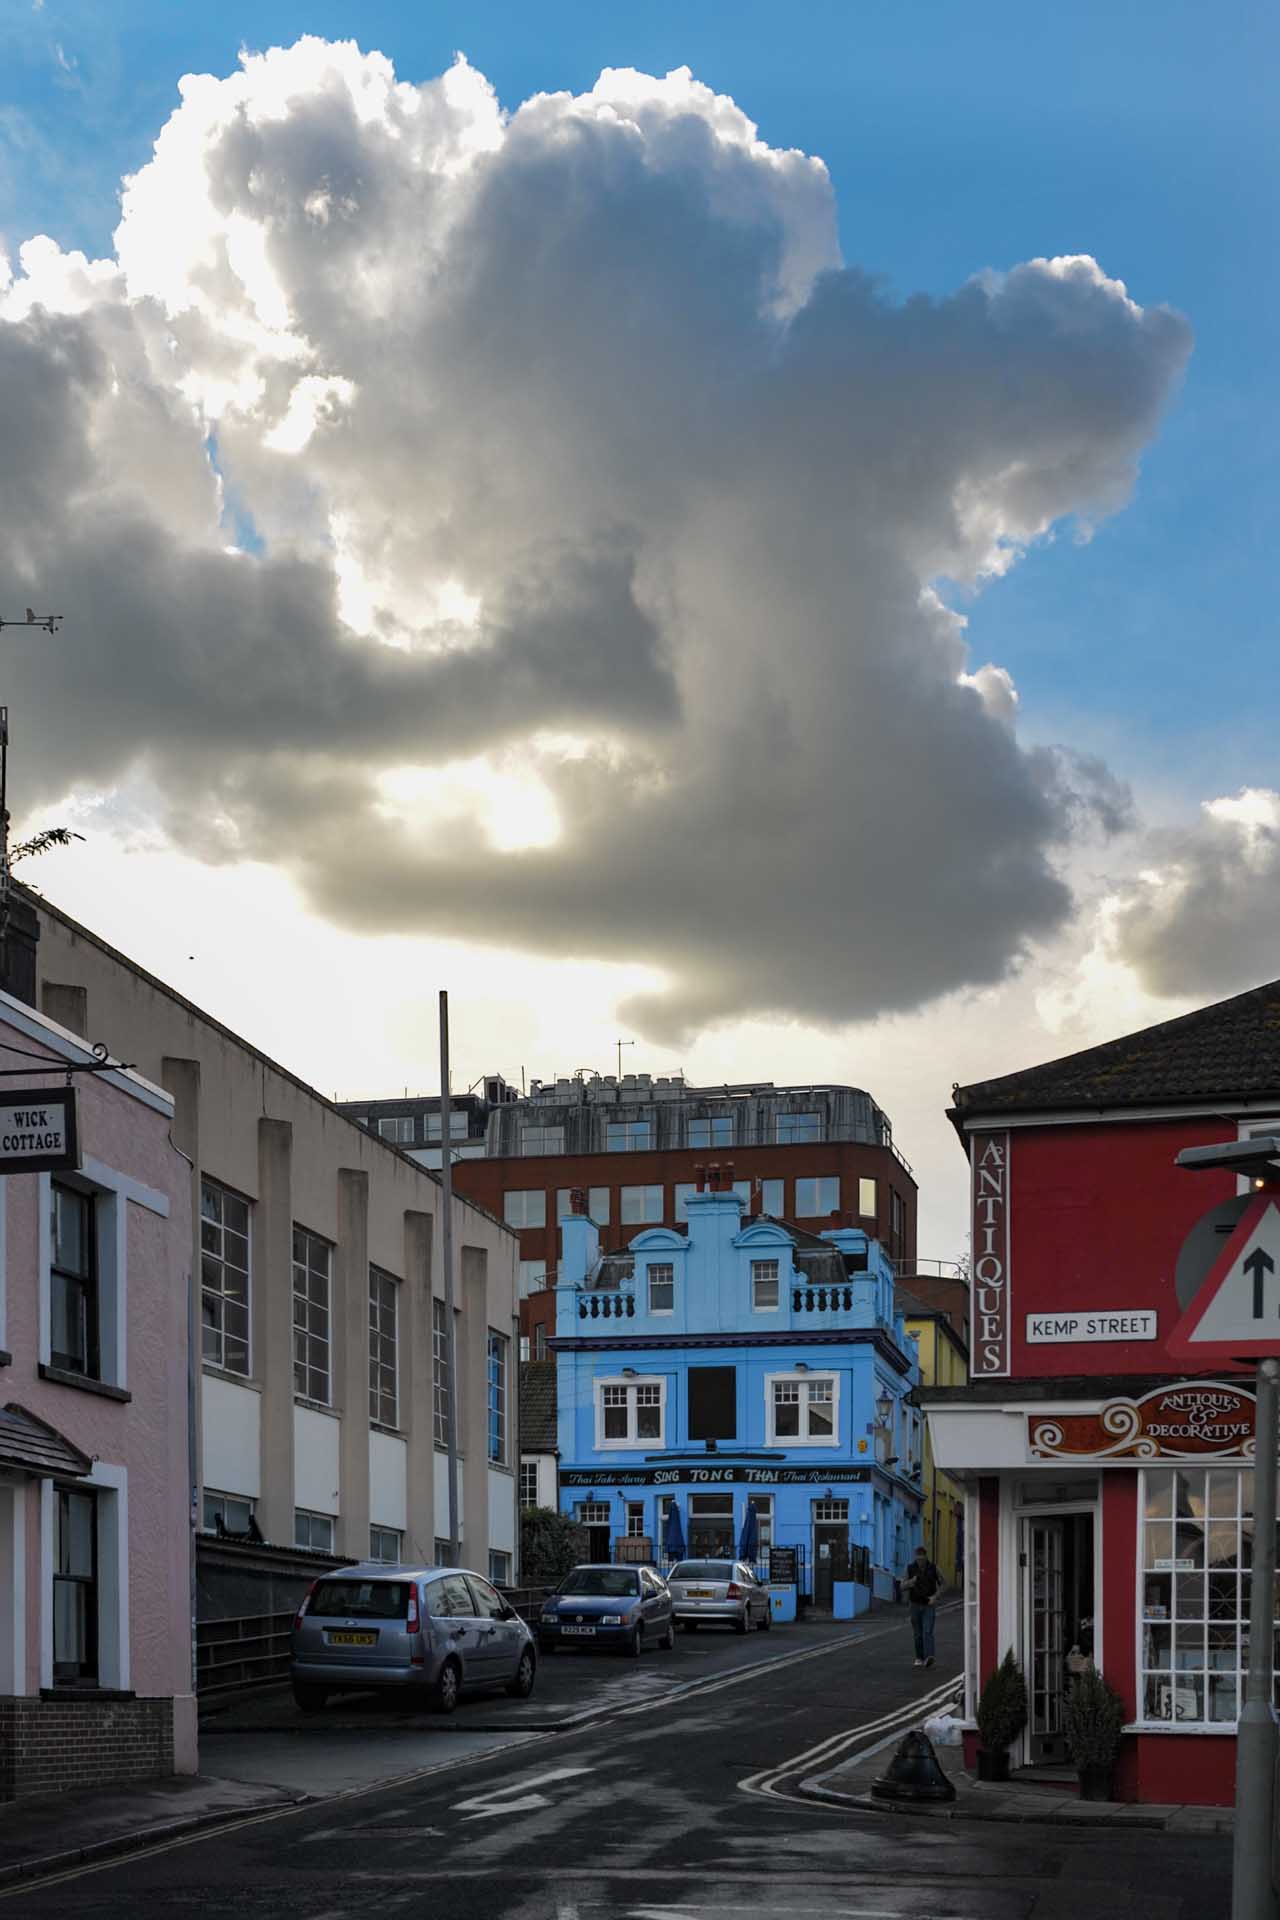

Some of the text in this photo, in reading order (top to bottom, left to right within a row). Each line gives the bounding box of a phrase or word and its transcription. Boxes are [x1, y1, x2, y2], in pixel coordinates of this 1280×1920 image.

[14, 1111, 48, 1128] WICK
[3, 1132, 61, 1151] COTTAGE
[975, 1139, 1004, 1372] ANTIQUES
[1032, 1317, 1151, 1336] KEMP STREET
[1160, 1393, 1241, 1412] ANTIQUES
[1146, 1423, 1250, 1442] DECORATIVE
[654, 1470, 680, 1484] SING
[690, 1469, 734, 1482] TONG
[745, 1469, 780, 1482] THAI
[808, 1471, 861, 1483] Restaurant
